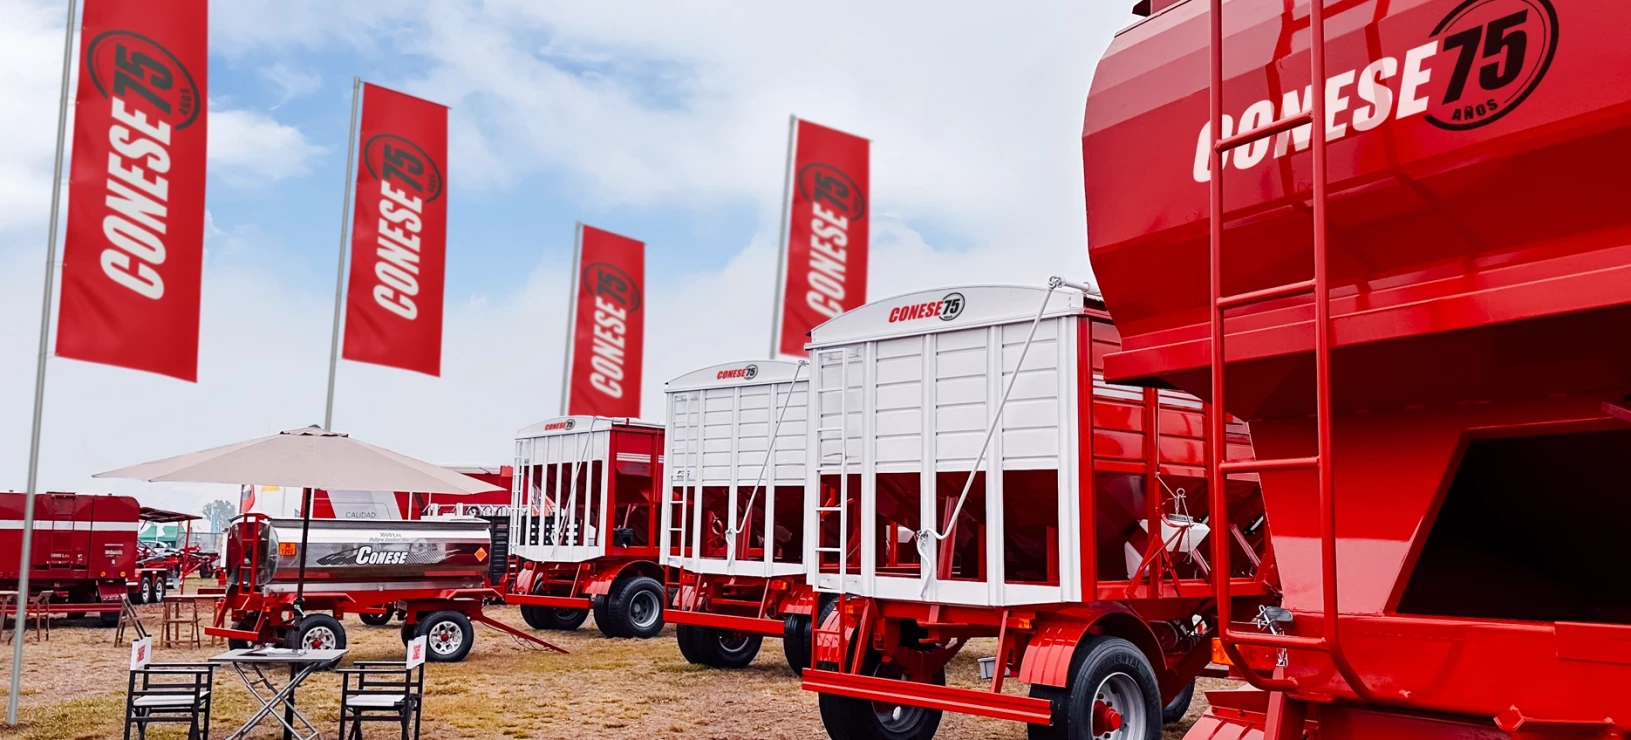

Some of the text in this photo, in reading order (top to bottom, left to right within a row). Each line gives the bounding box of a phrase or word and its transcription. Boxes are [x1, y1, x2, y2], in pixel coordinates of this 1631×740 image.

[1193, 10, 1528, 183] CONESE 75
[1451, 98, 1499, 121] AÑOS
[101, 44, 174, 300] CONESE 75
[374, 144, 424, 320] CONESE 75
[806, 172, 850, 320] CONESE 75
[590, 271, 627, 399] CONESE 75
[888, 298, 961, 323] CONESE 75
[716, 367, 756, 380] CONESE 75
[544, 422, 567, 431] CONESE
[345, 511, 377, 519] CALIDAD
